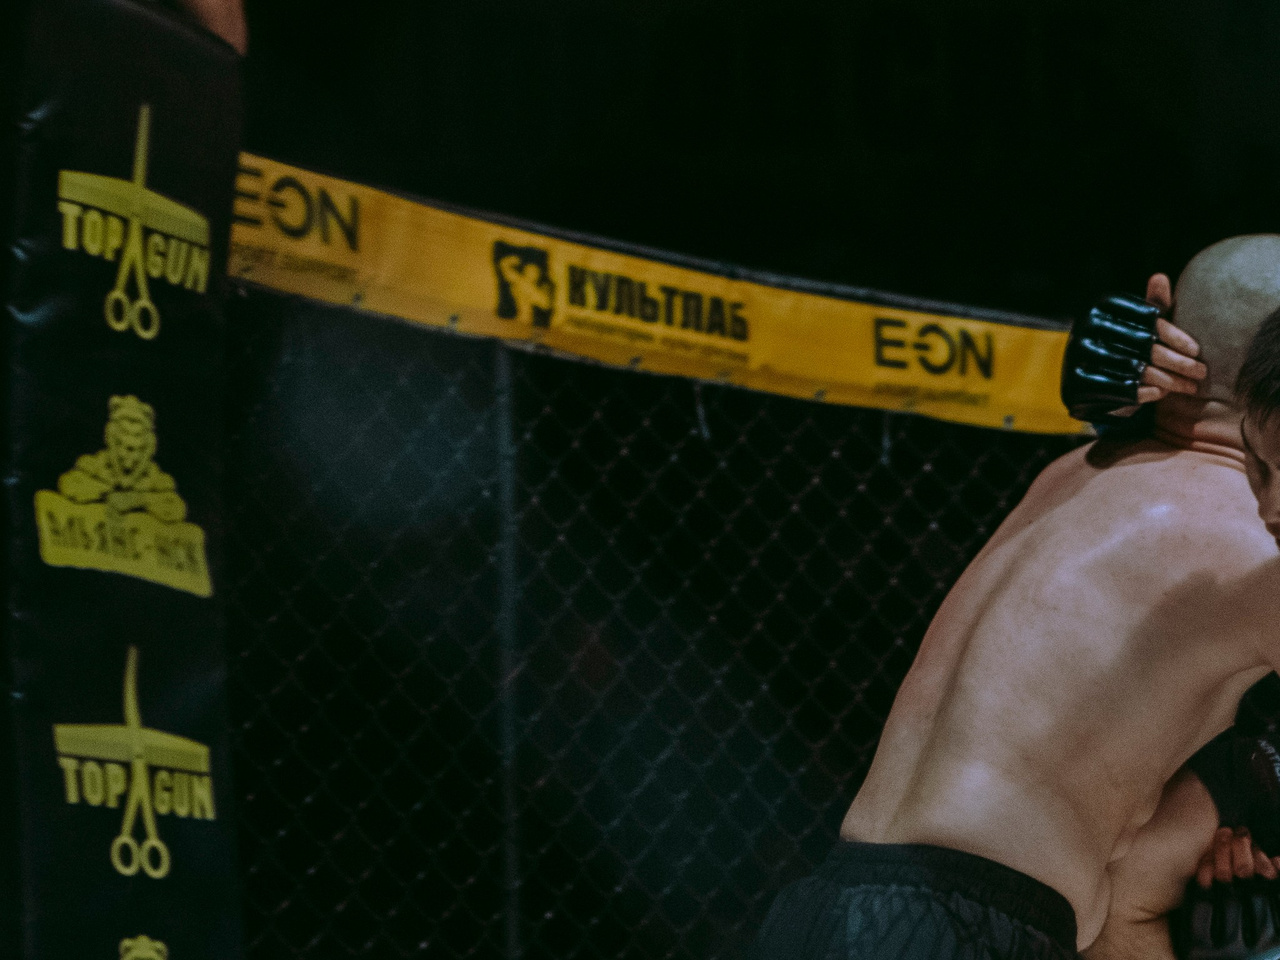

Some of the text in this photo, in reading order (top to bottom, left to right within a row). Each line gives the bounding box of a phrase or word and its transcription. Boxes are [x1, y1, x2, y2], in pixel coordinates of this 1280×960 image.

[58, 202, 123, 260] TOP
[147, 231, 210, 294] GUN
[58, 756, 217, 821] TOP GUN
